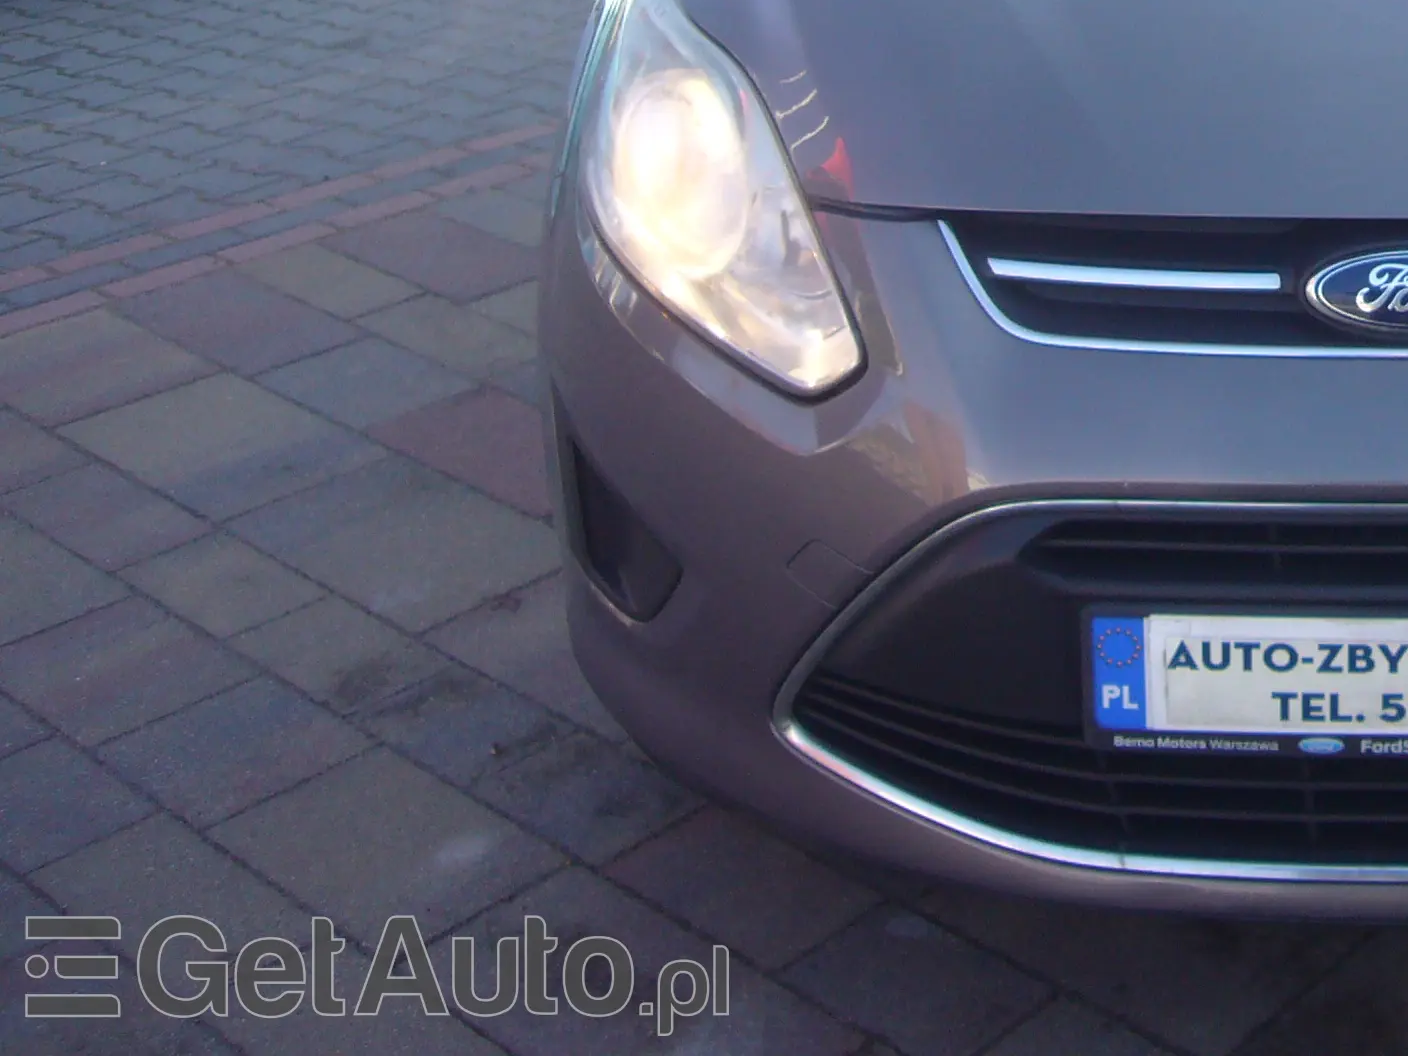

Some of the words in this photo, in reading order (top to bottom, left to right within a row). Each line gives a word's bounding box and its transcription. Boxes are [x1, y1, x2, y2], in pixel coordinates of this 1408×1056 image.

[1101, 684, 1139, 711] PL
[1271, 691, 1367, 723] TEL.
[1156, 736, 1208, 750] Motors
[1209, 738, 1280, 752] Warszawa
